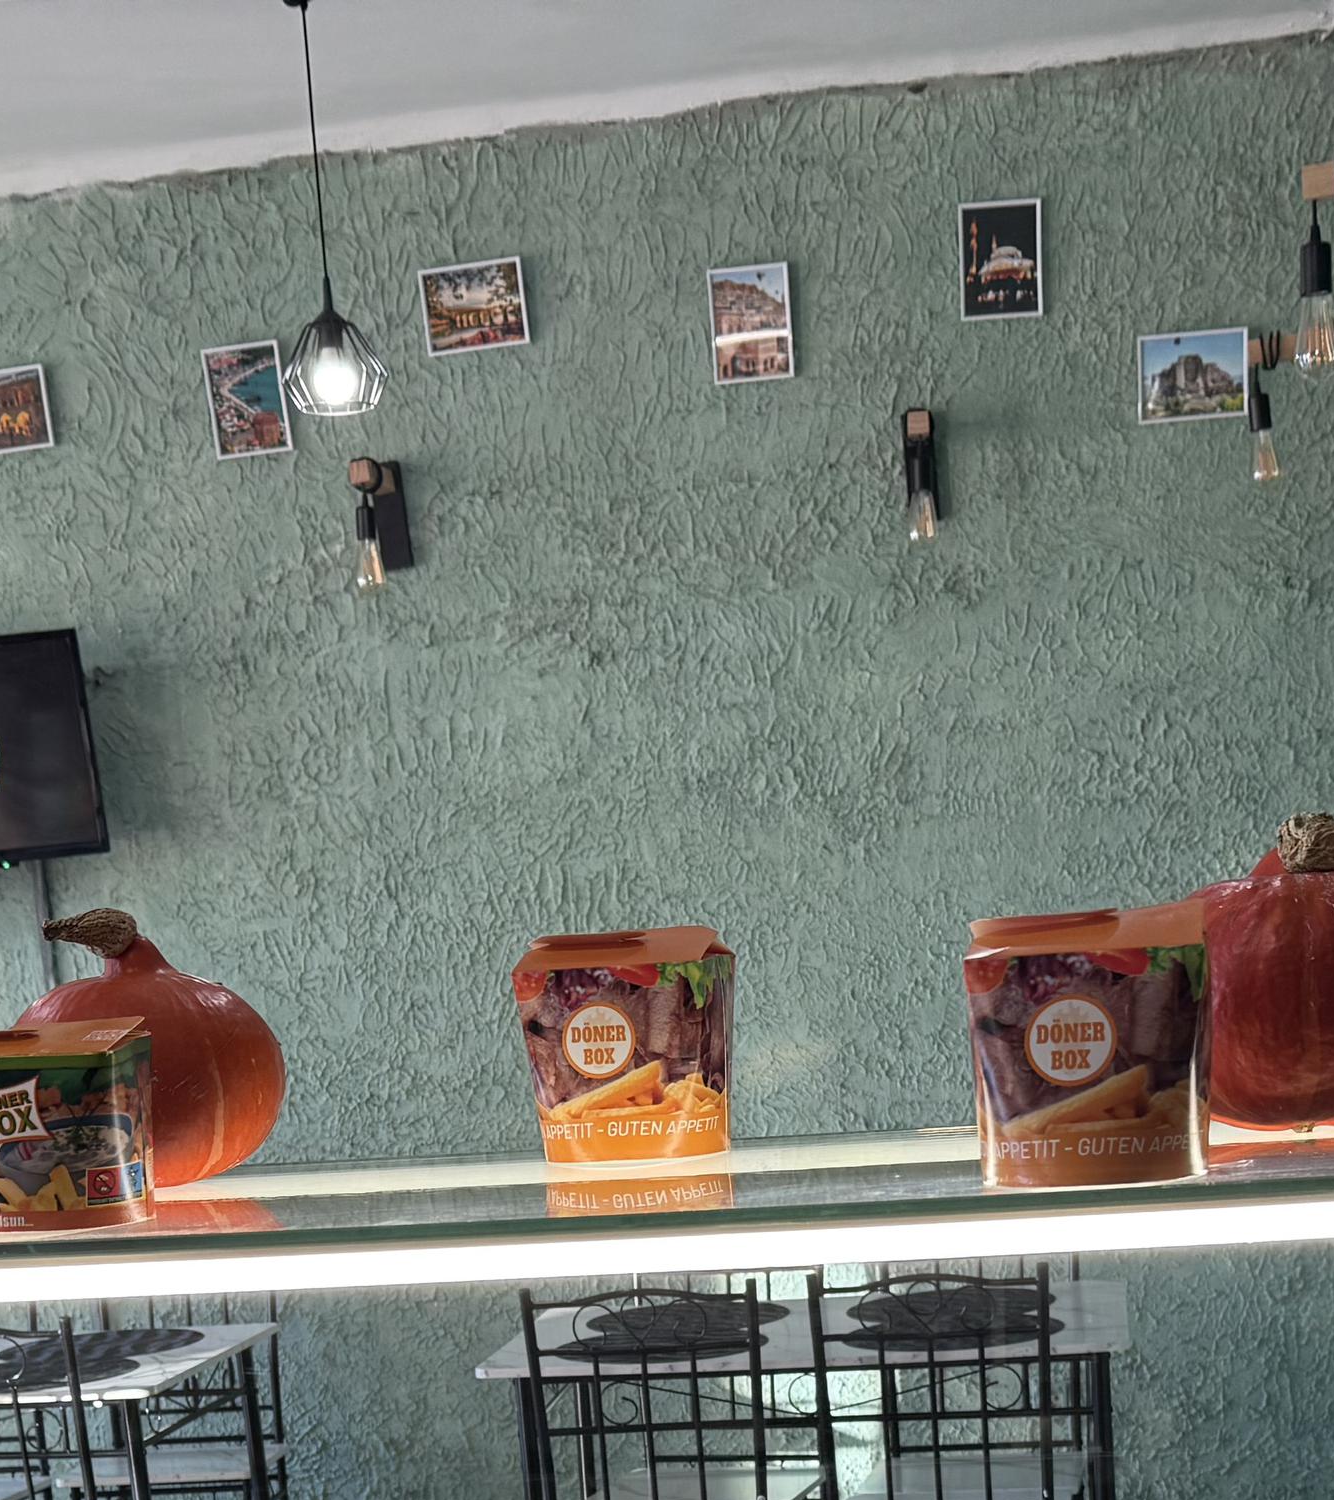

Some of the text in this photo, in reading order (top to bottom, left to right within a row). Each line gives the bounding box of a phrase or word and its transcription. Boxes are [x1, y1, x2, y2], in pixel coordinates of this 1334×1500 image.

[570, 1022, 627, 1043] DÖNER
[1036, 1018, 1106, 1044] DÖNER
[583, 1047, 616, 1066] BOX
[1051, 1048, 1091, 1070] BOX
[545, 1122, 594, 1140] APPETIT
[607, 1120, 663, 1137] GUTEN
[666, 1115, 720, 1135] APPETIT
[1077, 1136, 1145, 1156] GUTEN
